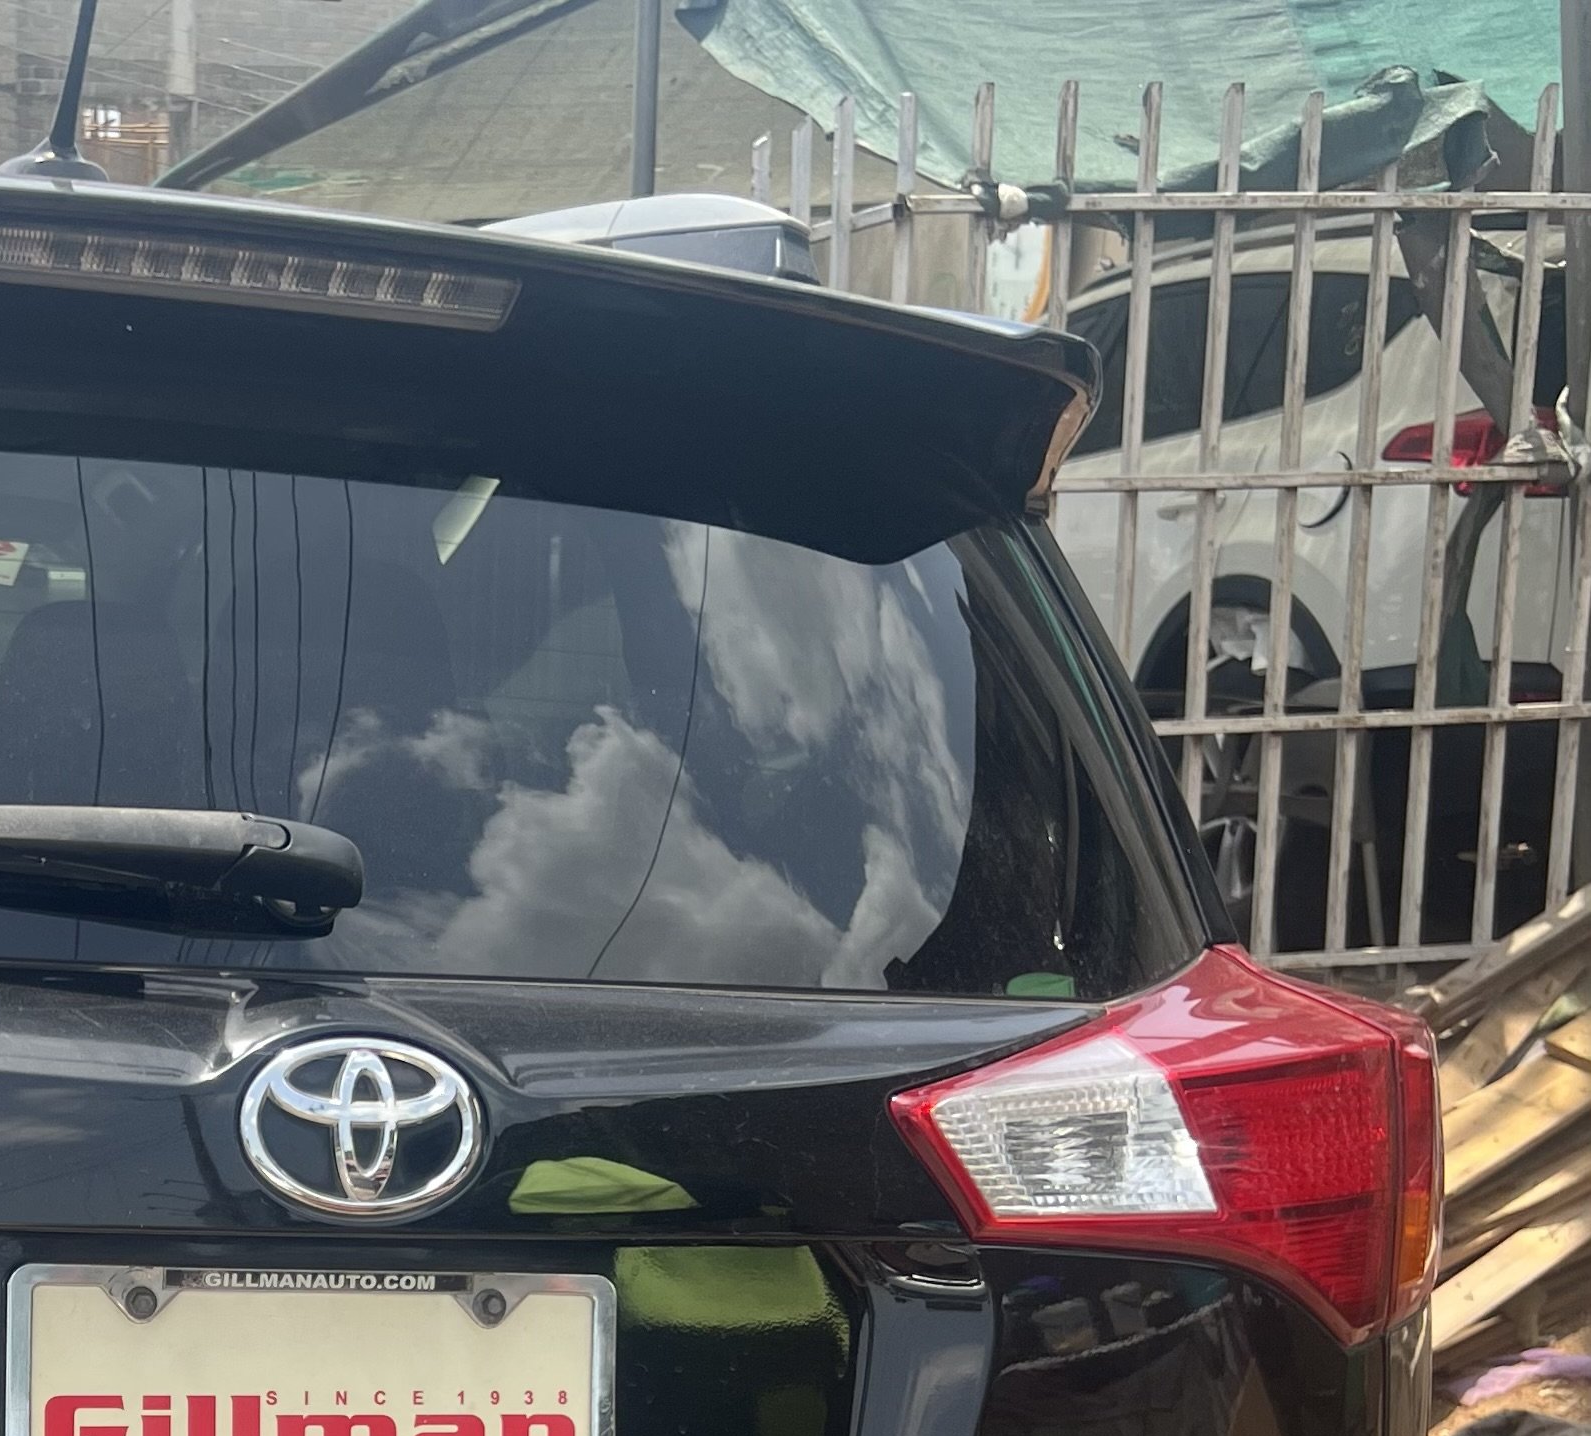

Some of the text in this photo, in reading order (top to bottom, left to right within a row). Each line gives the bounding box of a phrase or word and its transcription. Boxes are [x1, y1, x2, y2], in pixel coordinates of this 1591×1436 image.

[205, 1272, 436, 1291] GILLMANAUTO.COM
[265, 1390, 569, 1406] SINCE 1938
